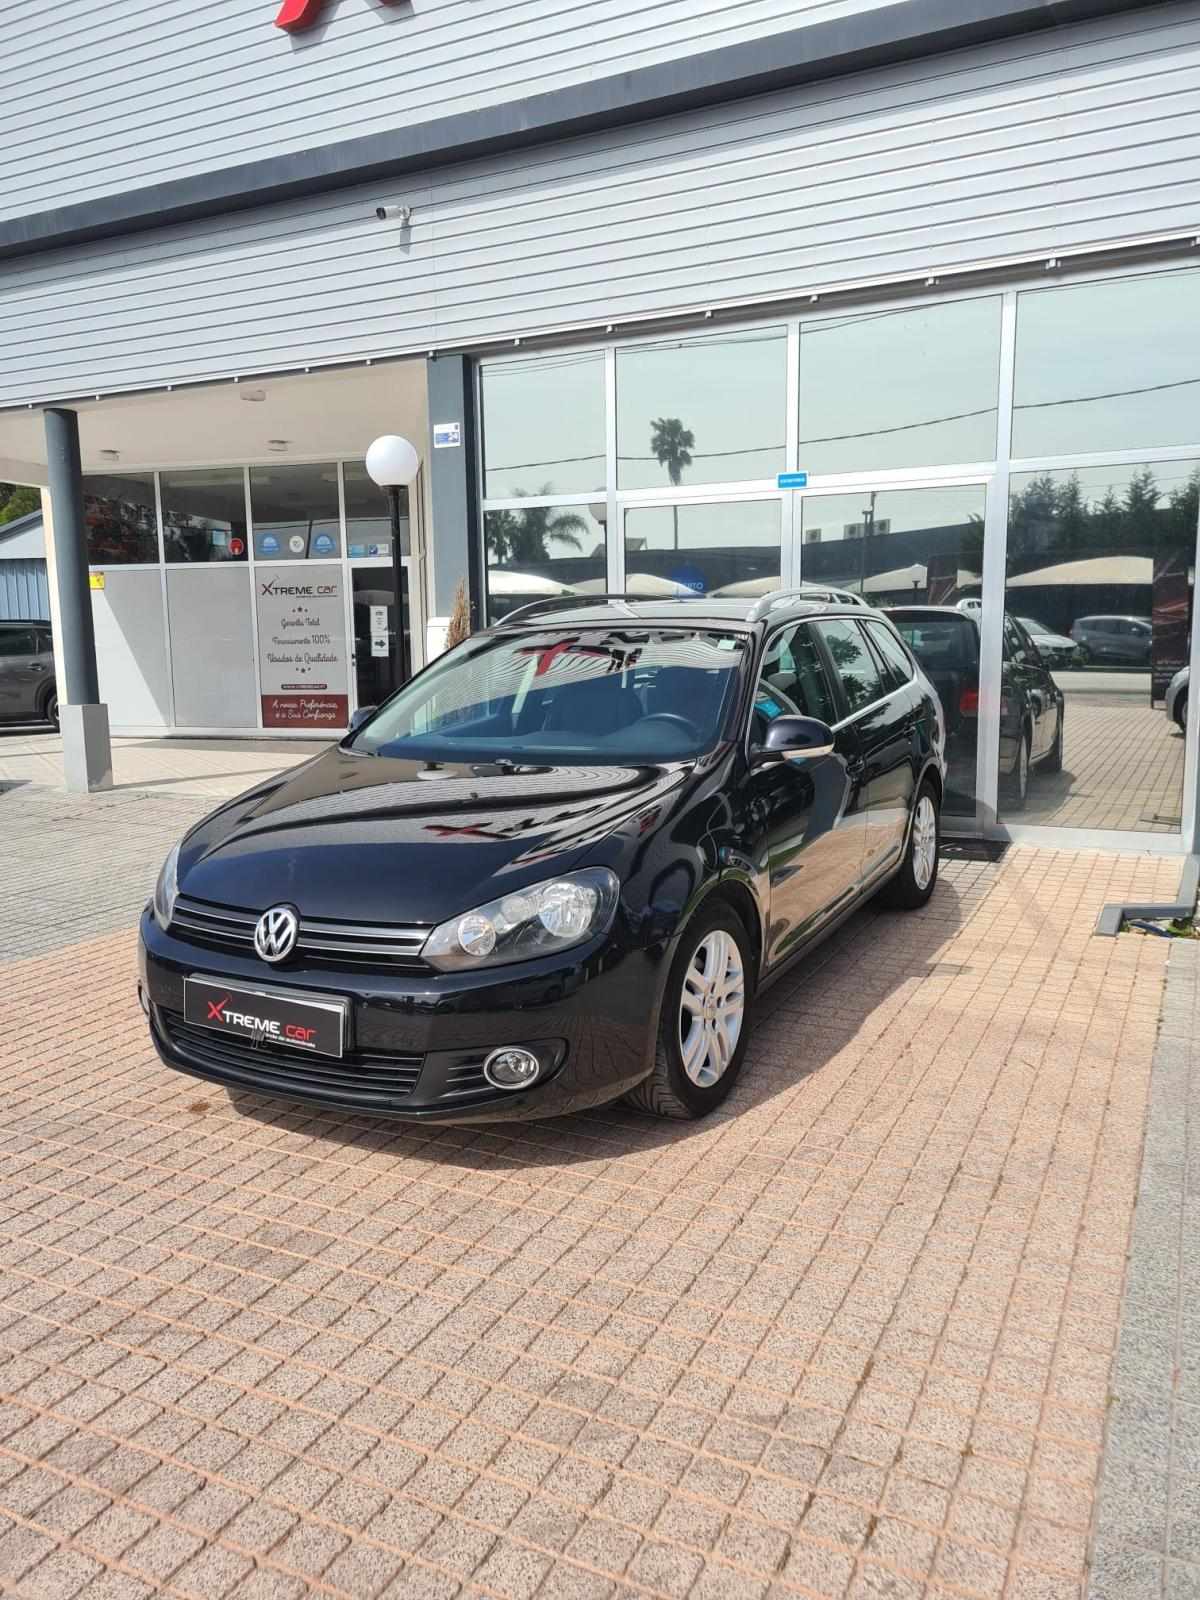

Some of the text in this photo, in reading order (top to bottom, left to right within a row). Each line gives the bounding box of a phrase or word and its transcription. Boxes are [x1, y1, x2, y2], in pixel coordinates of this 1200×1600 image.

[261, 580, 337, 596] XTREME car
[311, 634, 330, 644] 100%
[207, 995, 281, 1034] XTREME
[284, 1023, 317, 1041] car
